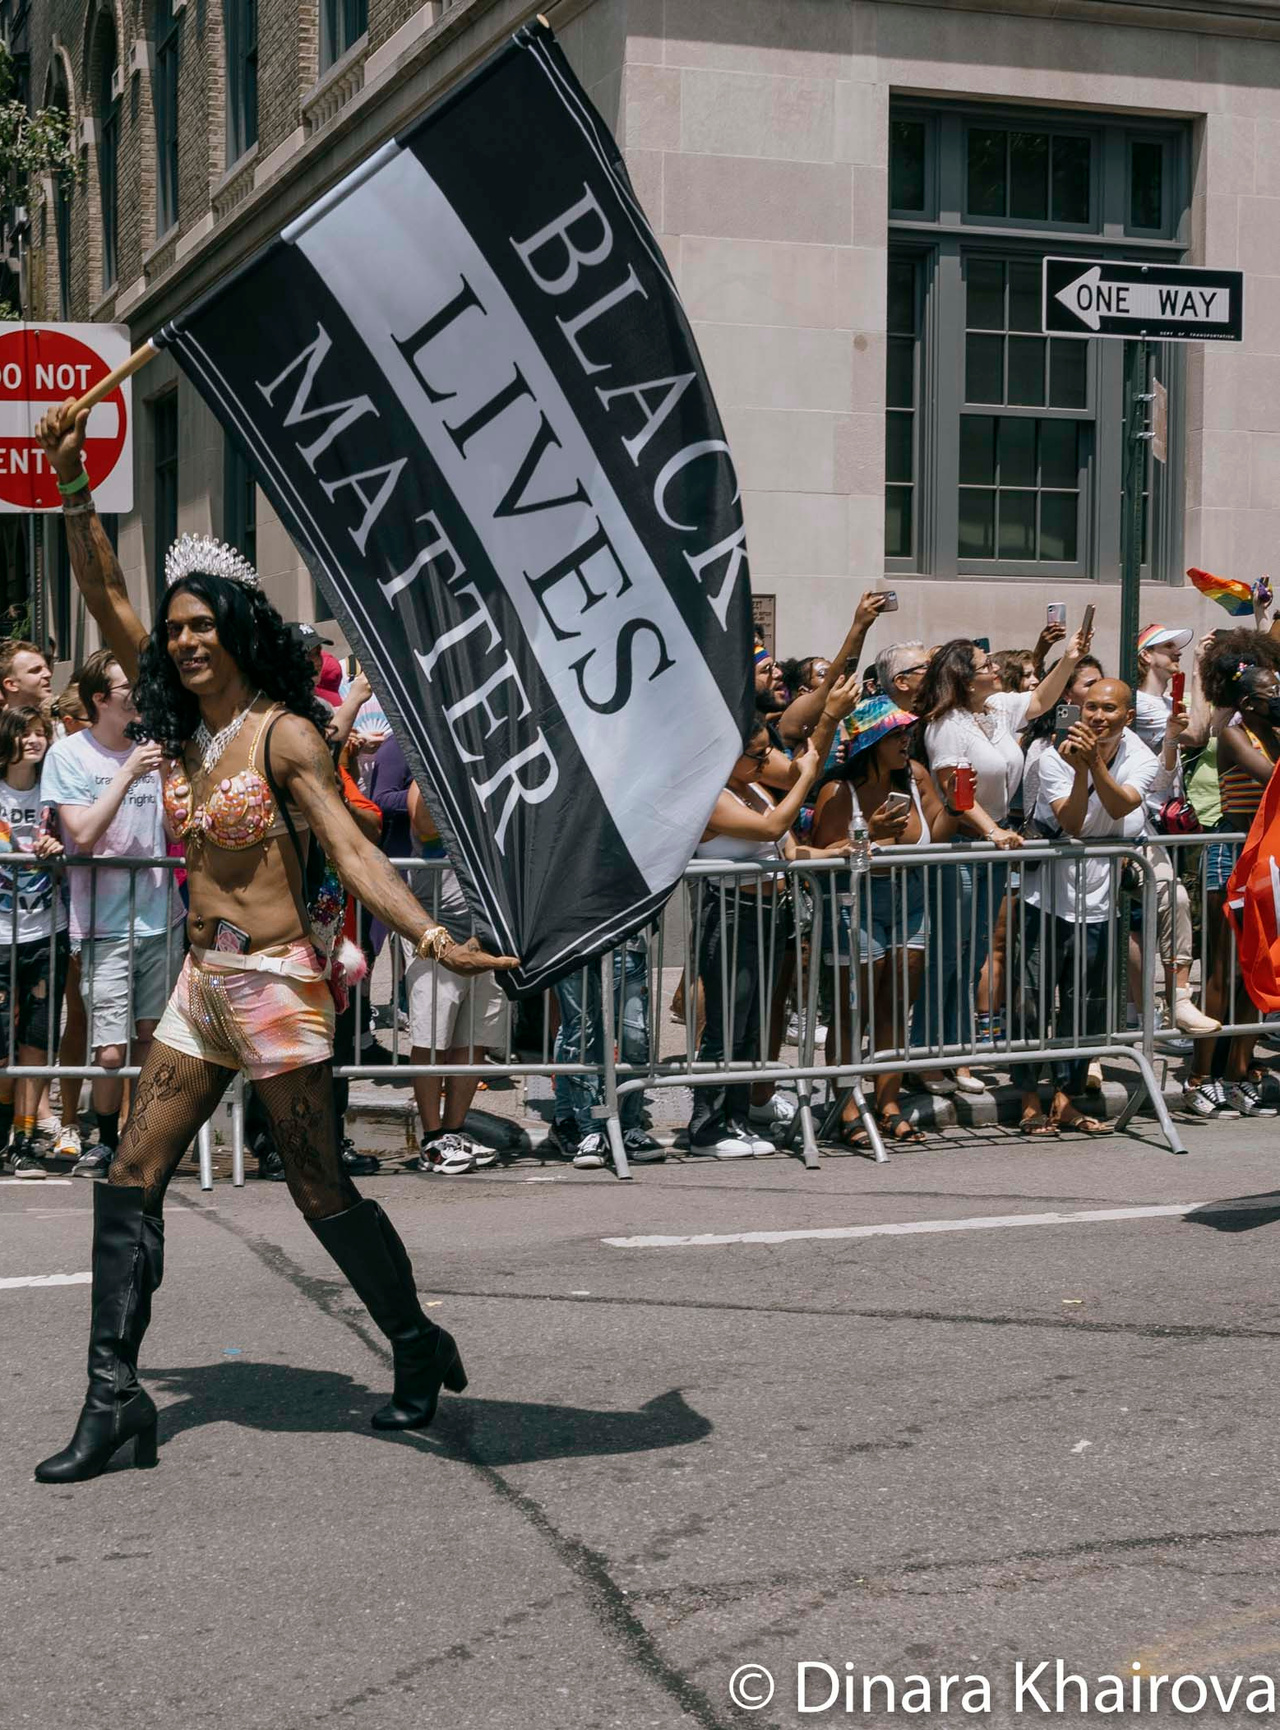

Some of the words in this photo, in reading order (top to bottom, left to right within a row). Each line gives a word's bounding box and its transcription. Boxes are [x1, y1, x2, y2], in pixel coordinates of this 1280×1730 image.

[35, 364, 92, 390] NOT
[390, 273, 675, 715] LIVES
[509, 181, 752, 632] BLACK
[1076, 284, 1130, 313] ONE
[1159, 289, 1217, 317] WAY
[255, 321, 560, 853] MATTER
